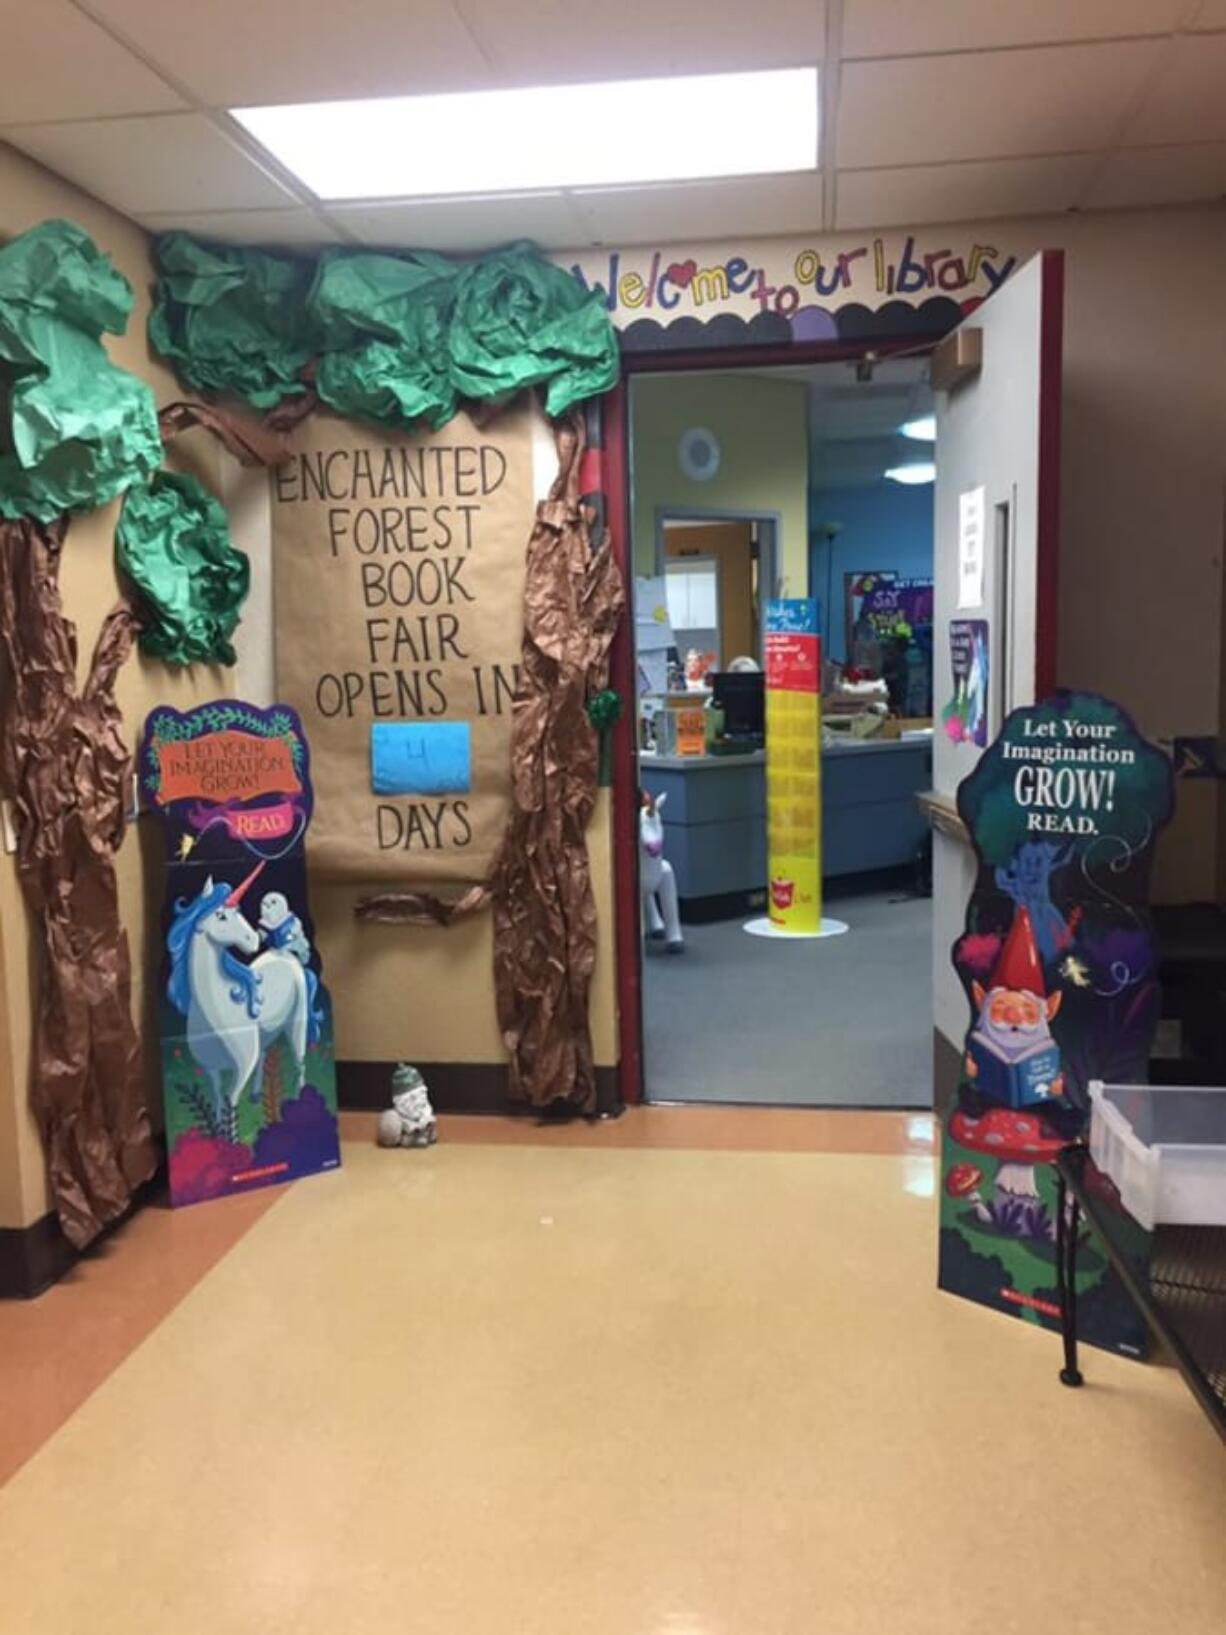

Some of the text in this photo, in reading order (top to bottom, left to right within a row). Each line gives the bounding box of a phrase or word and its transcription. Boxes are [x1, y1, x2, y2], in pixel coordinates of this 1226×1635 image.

[750, 268, 799, 320] to
[794, 246, 867, 296] our
[873, 236, 1016, 298] library
[275, 445, 507, 503] ENCHANTED
[328, 505, 481, 557] FOREST
[361, 556, 475, 608] BOOK
[366, 613, 469, 664] FAIR
[315, 664, 520, 718] OPENS IN
[1023, 719, 1117, 739] Let Your
[169, 756, 284, 777] IMAGINATION
[184, 741, 265, 759] LET YOUR
[406, 737, 432, 773] 4
[1002, 741, 1136, 765] Imagination
[200, 773, 260, 793] GROW!
[1014, 765, 1116, 812] GROW!
[237, 812, 286, 835] READ
[376, 800, 473, 851] DAYS
[1026, 812, 1100, 836] READ.
